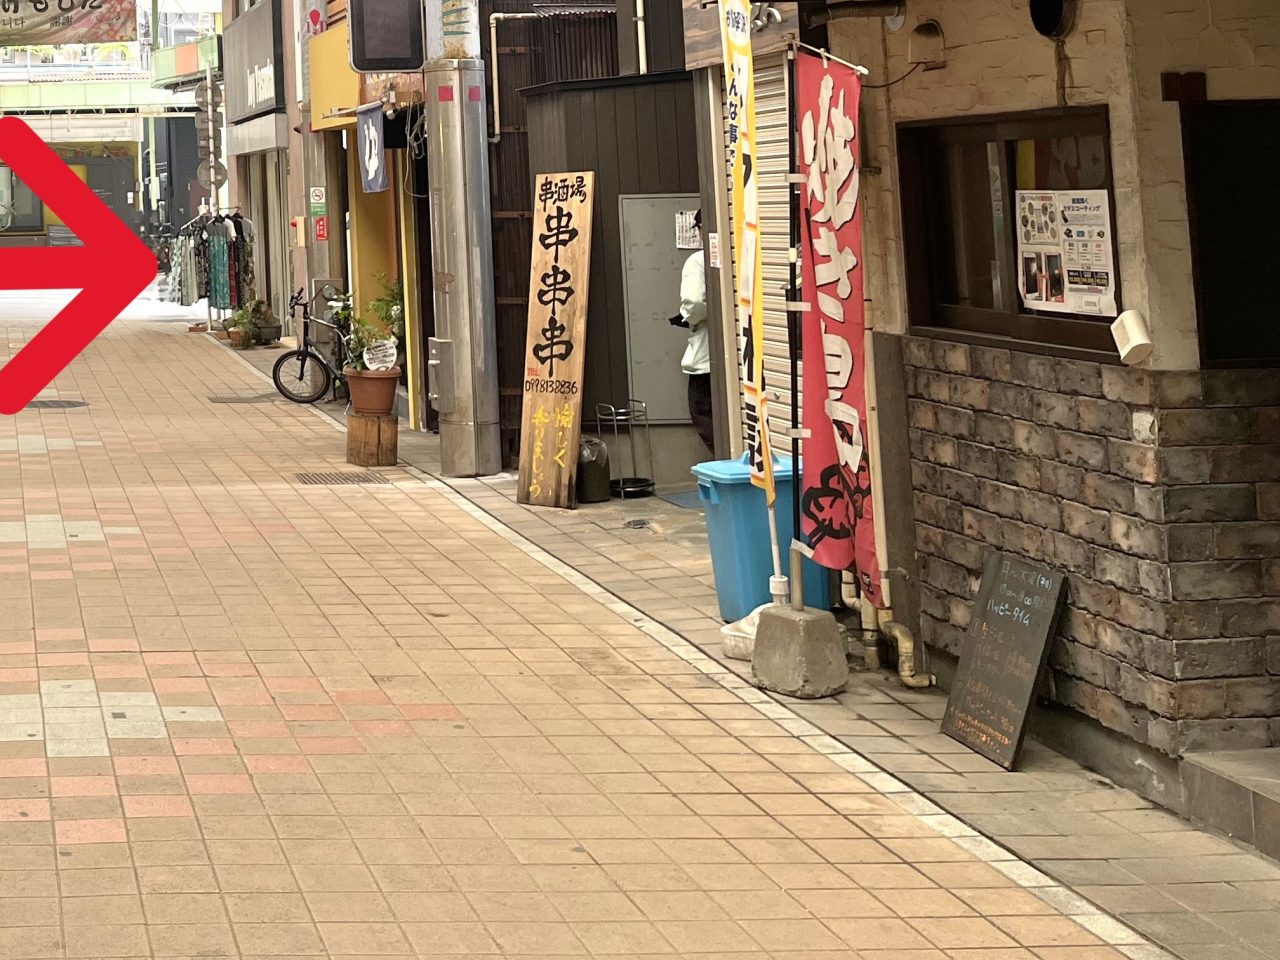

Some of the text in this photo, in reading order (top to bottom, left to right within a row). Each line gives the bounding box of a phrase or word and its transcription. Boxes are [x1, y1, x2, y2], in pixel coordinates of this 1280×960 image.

[539, 176, 587, 212] 串酒場
[527, 368, 540, 376] TEL
